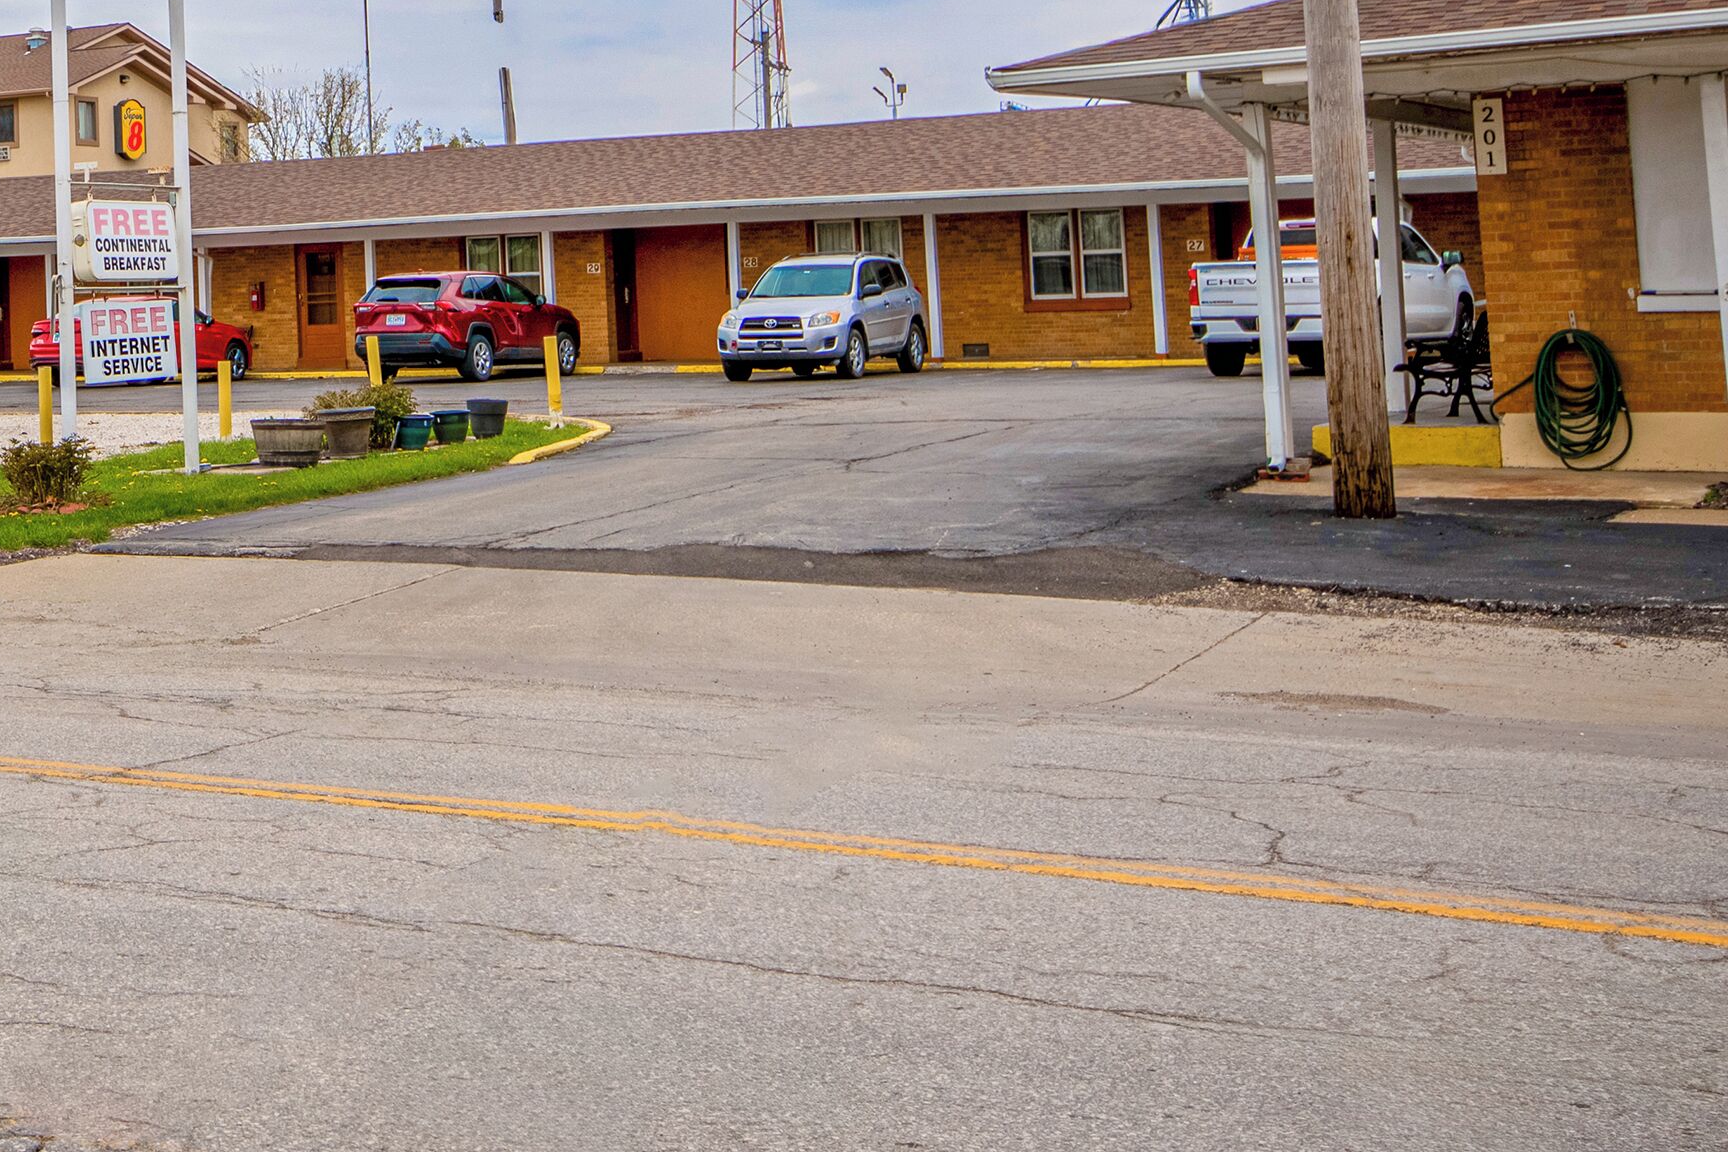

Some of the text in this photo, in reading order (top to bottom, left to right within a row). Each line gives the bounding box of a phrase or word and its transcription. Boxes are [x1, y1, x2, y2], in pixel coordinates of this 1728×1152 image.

[124, 107, 143, 126] Super
[127, 120, 144, 151] 8
[1481, 106, 1497, 168] 201
[92, 208, 170, 237] FREE
[95, 237, 172, 253] CONTINENTAL
[1188, 240, 1203, 250] 27
[103, 256, 167, 271] BREAKFAST
[744, 258, 757, 267] 28
[90, 306, 168, 336] FREE
[90, 335, 170, 358] INTERNET
[103, 355, 163, 376] SERVICE
